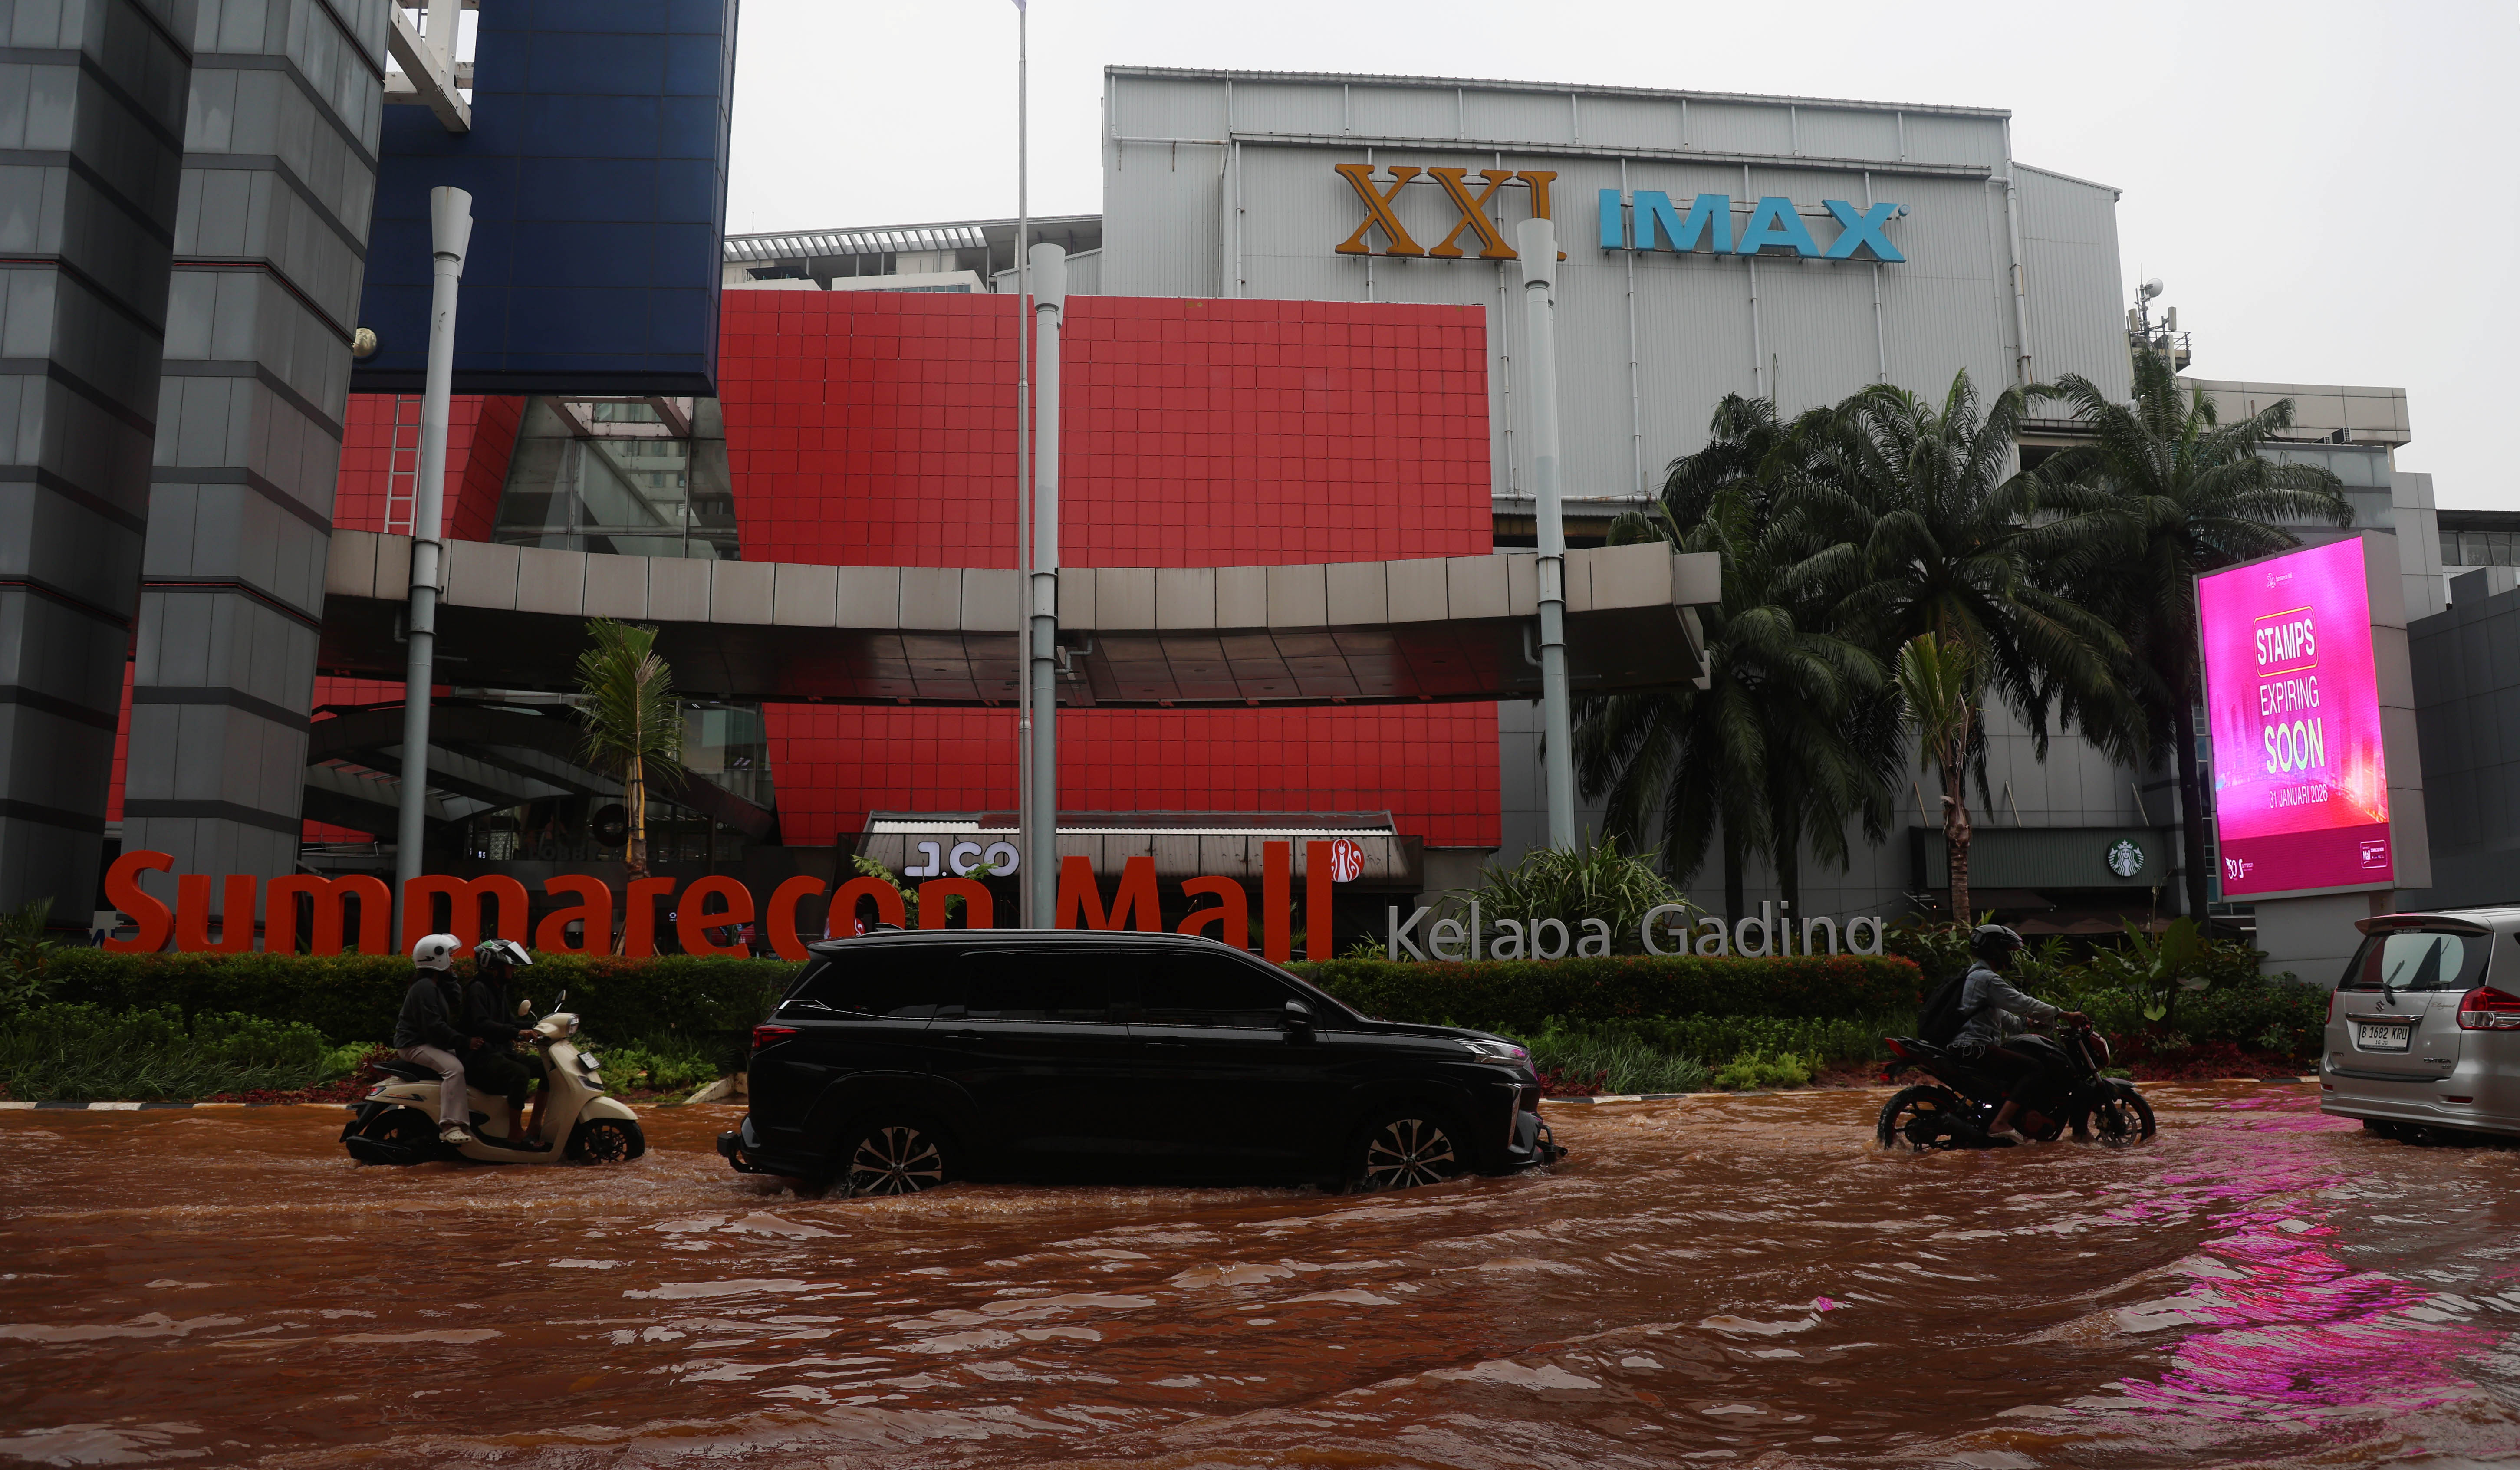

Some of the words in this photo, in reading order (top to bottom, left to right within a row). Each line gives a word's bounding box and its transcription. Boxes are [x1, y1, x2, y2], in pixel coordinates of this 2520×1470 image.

[1335, 163, 1566, 261] XXI
[1599, 188, 1906, 263] IMAX
[2256, 618, 2315, 666] STAMPS
[2260, 675, 2319, 716] EXPIRING
[2264, 717, 2325, 774] SOON
[2269, 791, 2277, 808] 31
[2279, 786, 2309, 807] JANUARI
[2311, 784, 2328, 803] 2026
[904, 841, 1020, 877] J.CO
[102, 849, 993, 960] Summarecon
[1055, 840, 1332, 962] Mall
[1388, 900, 1611, 961] Kelapa
[1641, 900, 1882, 957] Gading
[2362, 1026, 2367, 1038] B
[2369, 1026, 2388, 1039] 1682
[2391, 1027, 2407, 1040] KRU
